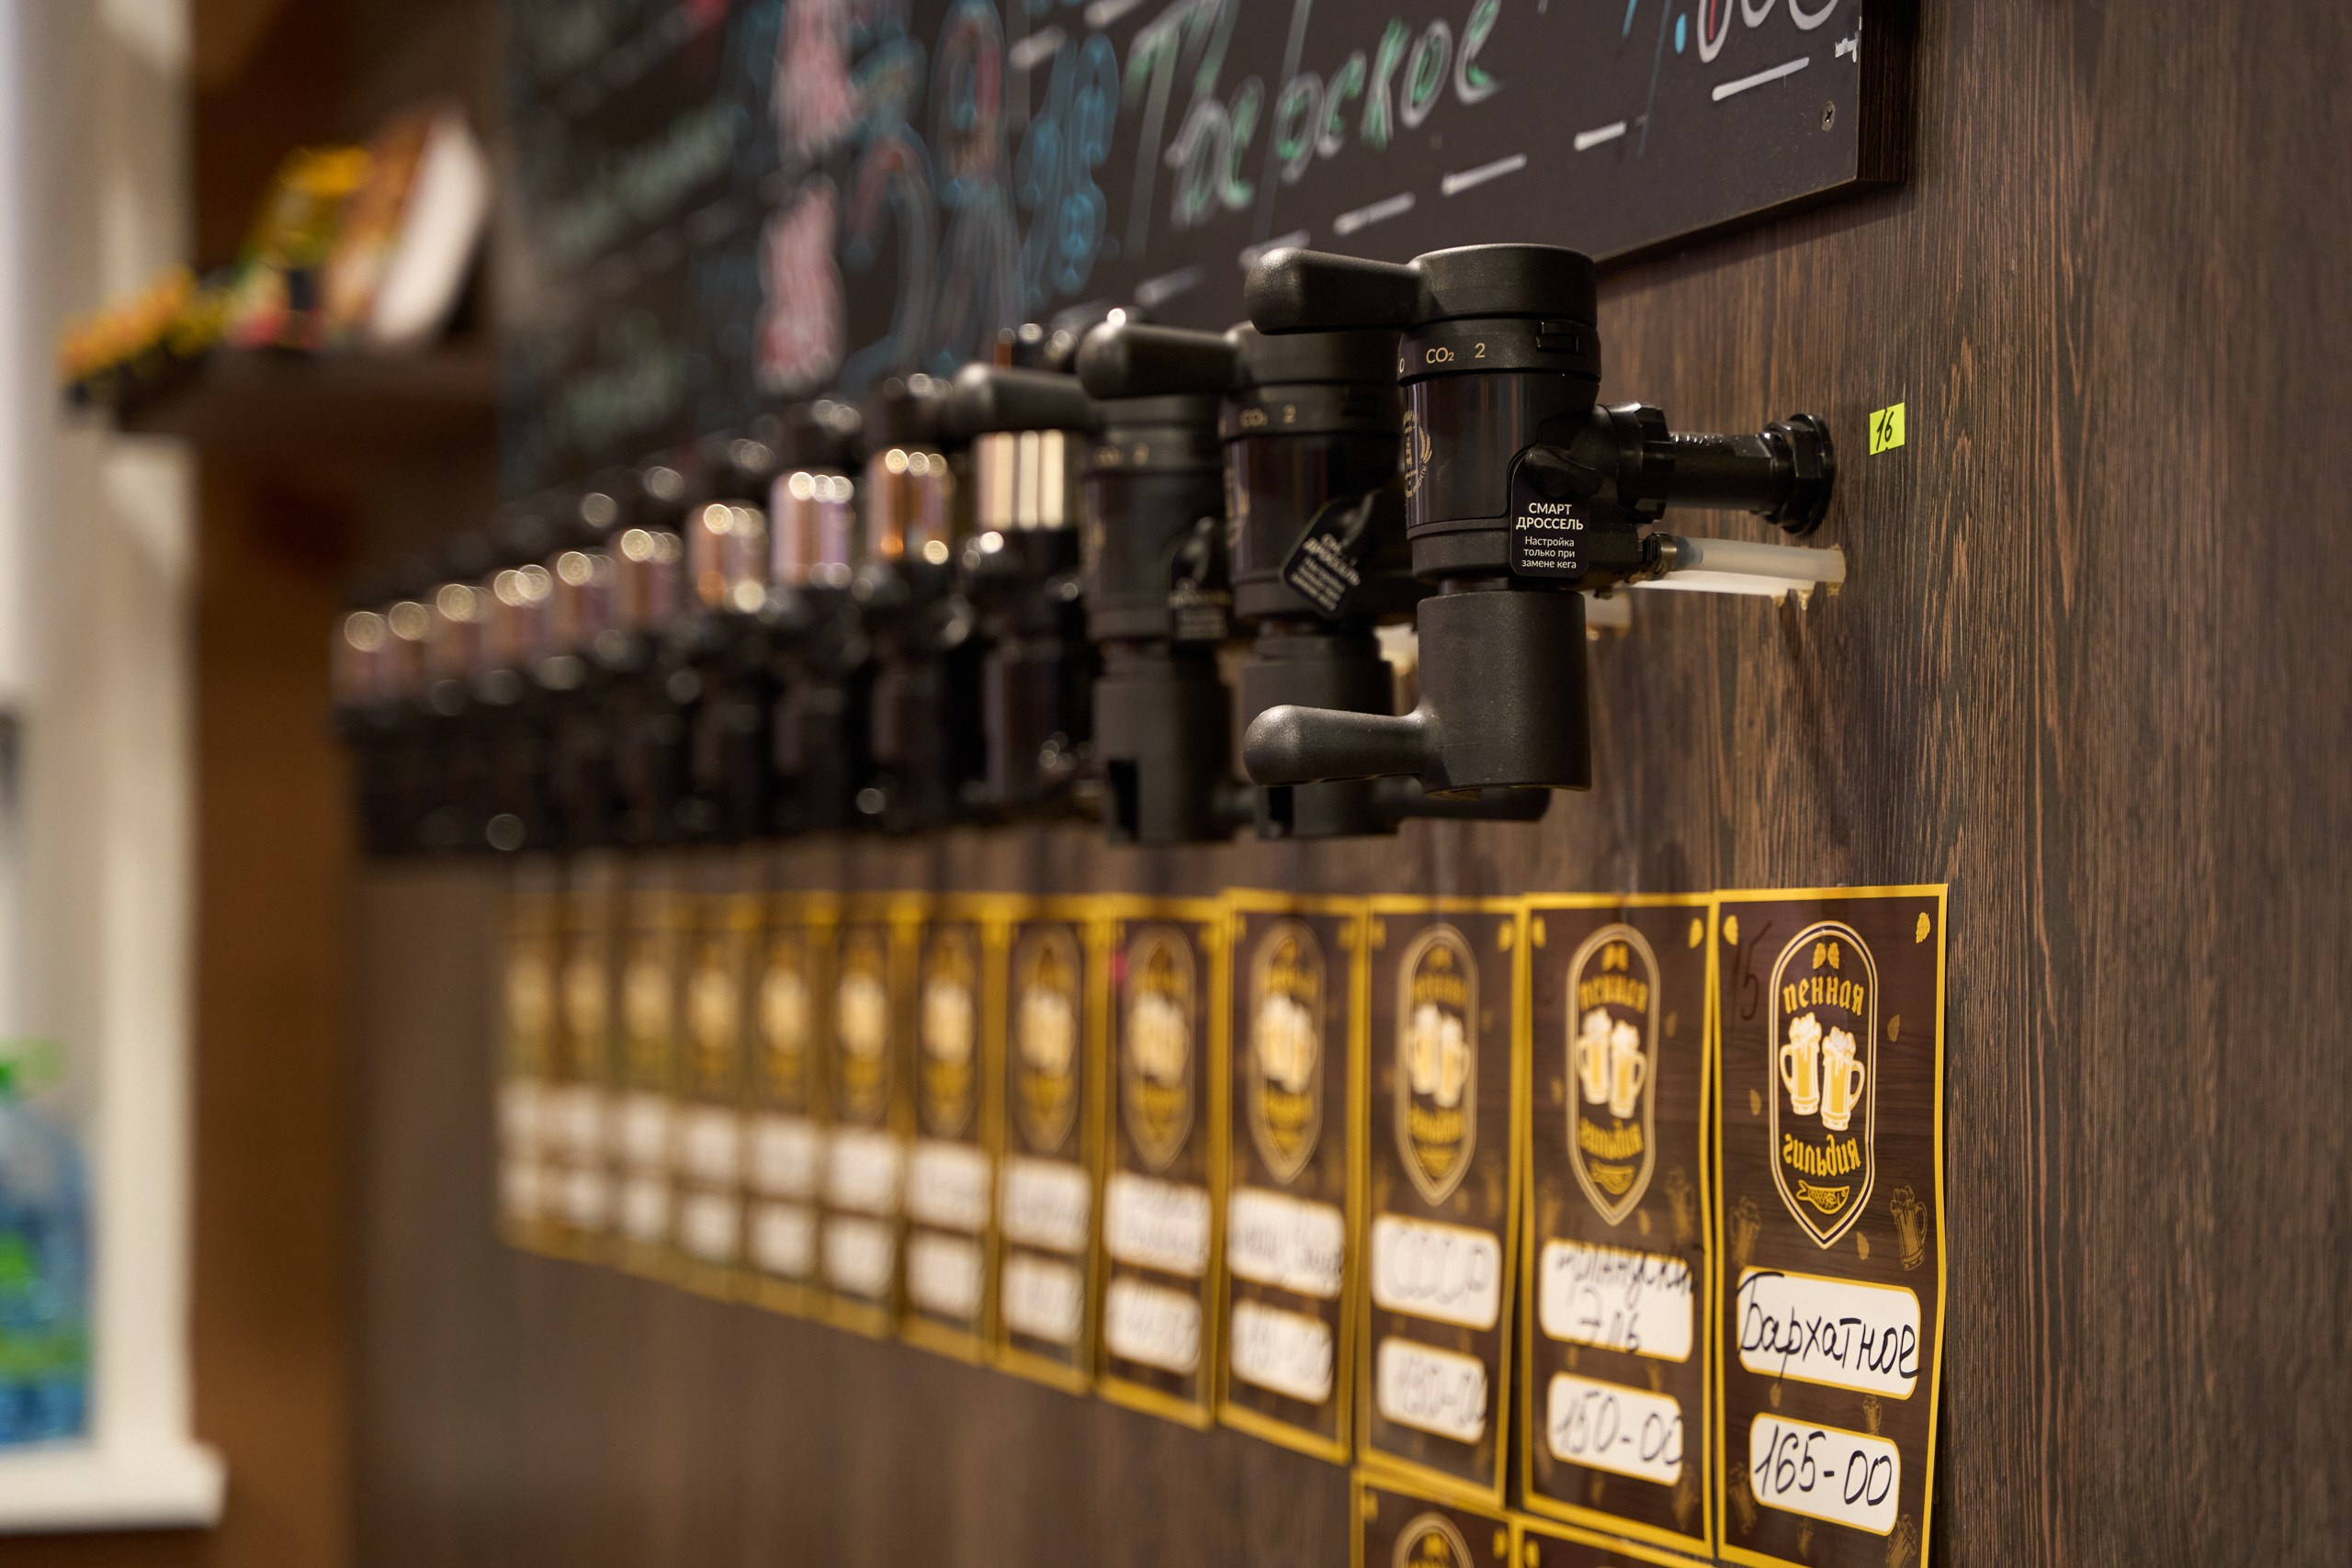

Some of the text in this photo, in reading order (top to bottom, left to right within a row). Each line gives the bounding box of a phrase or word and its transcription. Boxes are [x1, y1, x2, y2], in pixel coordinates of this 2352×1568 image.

[1426, 347, 1455, 365] CO2
[1475, 343, 1486, 359] 2
[1876, 409, 1895, 451] 16
[1528, 502, 1573, 515] СМАРТ
[1515, 516, 1584, 531] ДРОССЕЛЬ
[1524, 536, 1575, 547] Настройка
[1523, 548, 1576, 559] только при
[1521, 559, 1577, 569] замене кега
[1736, 1271, 1922, 1382] Бархатное
[1754, 1424, 1893, 1506] 165-00
